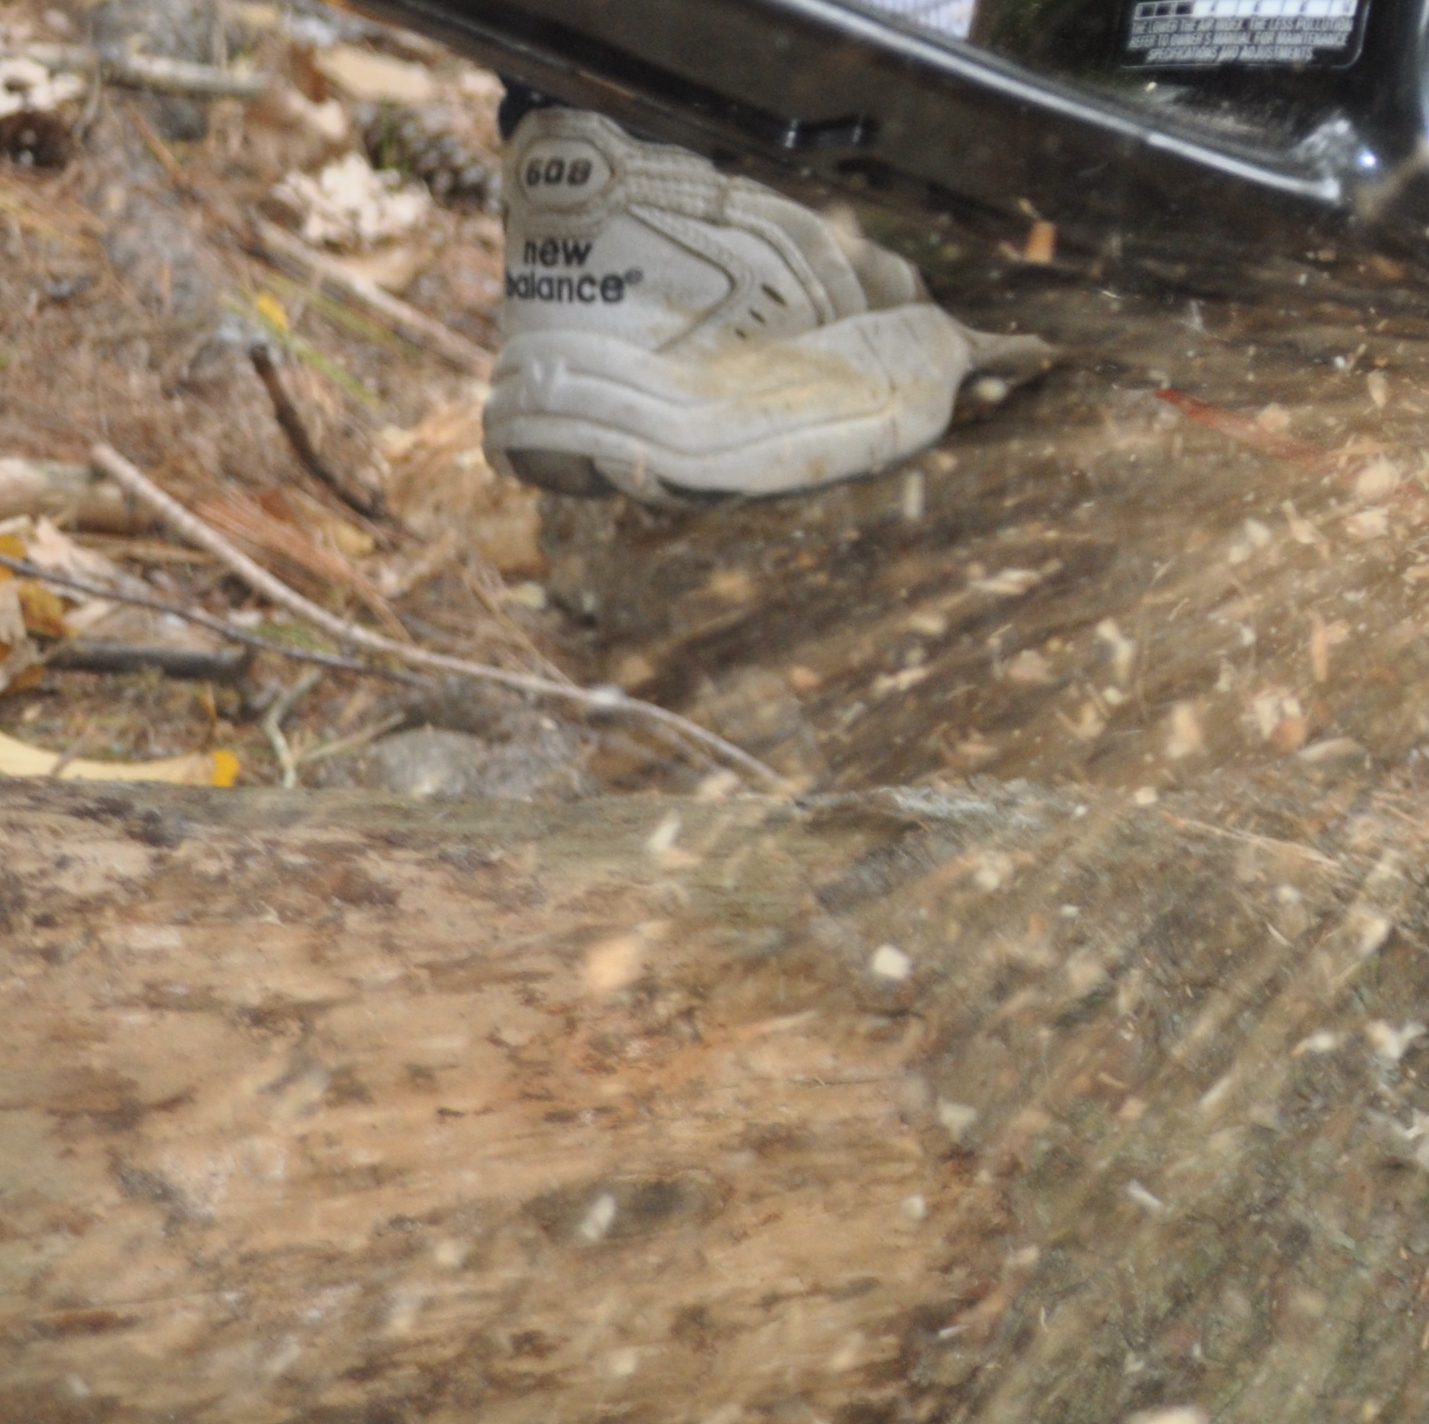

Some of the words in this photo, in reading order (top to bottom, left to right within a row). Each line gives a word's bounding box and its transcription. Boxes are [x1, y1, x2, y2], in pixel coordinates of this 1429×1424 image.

[1271, 16, 1296, 31] LESS
[1129, 33, 1157, 49] REFER
[1158, 33, 1170, 47] TO
[1213, 31, 1252, 46] MANUAL
[1252, 31, 1276, 46] FOR
[1276, 31, 1349, 47] MAINTENANCE
[1147, 46, 1219, 62] SPECIFICATIONS
[522, 238, 594, 268] new
